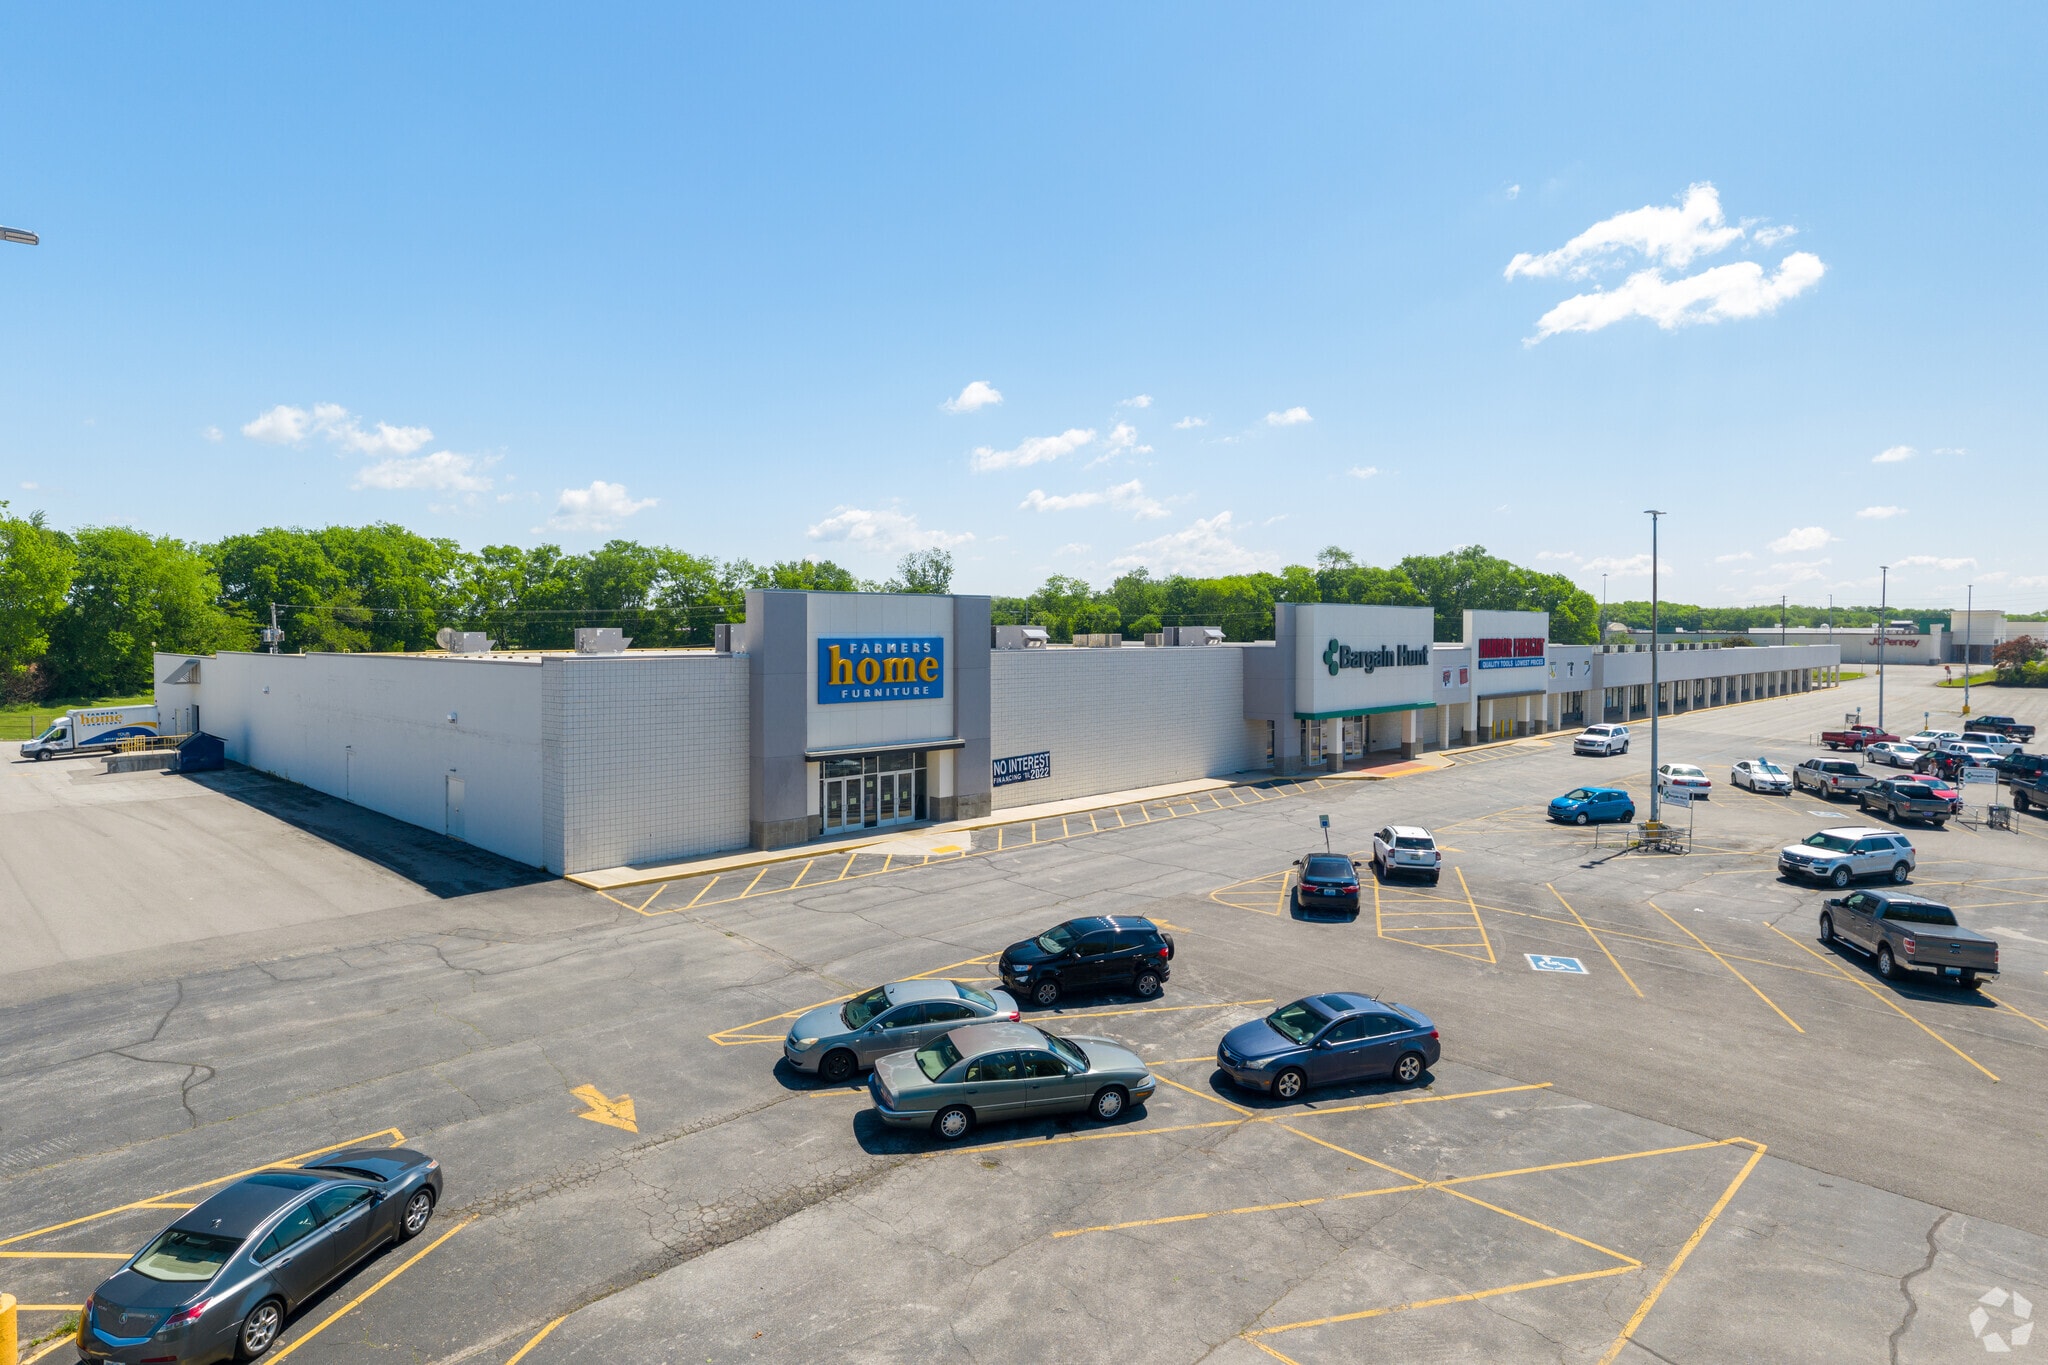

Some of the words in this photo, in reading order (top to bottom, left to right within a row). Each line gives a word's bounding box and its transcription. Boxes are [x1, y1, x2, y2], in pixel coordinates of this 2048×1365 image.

[849, 643, 931, 654] FARMERS
[1513, 638, 1545, 657] FREIGHT
[828, 644, 939, 685] home
[1339, 645, 1395, 674] Bargain
[1396, 644, 1429, 666] Hunt
[1482, 661, 1500, 669] QUALITY
[1500, 660, 1514, 668] TOOLS
[1514, 659, 1530, 667] LOWEST
[1530, 658, 1544, 666] PRICES
[841, 686, 929, 699] FURNITURE
[80, 713, 123, 725] home
[993, 761, 1007, 776] NO
[1008, 753, 1050, 773] INTEREST
[993, 773, 1022, 784] FINANCING
[1030, 767, 1050, 780] 2022
